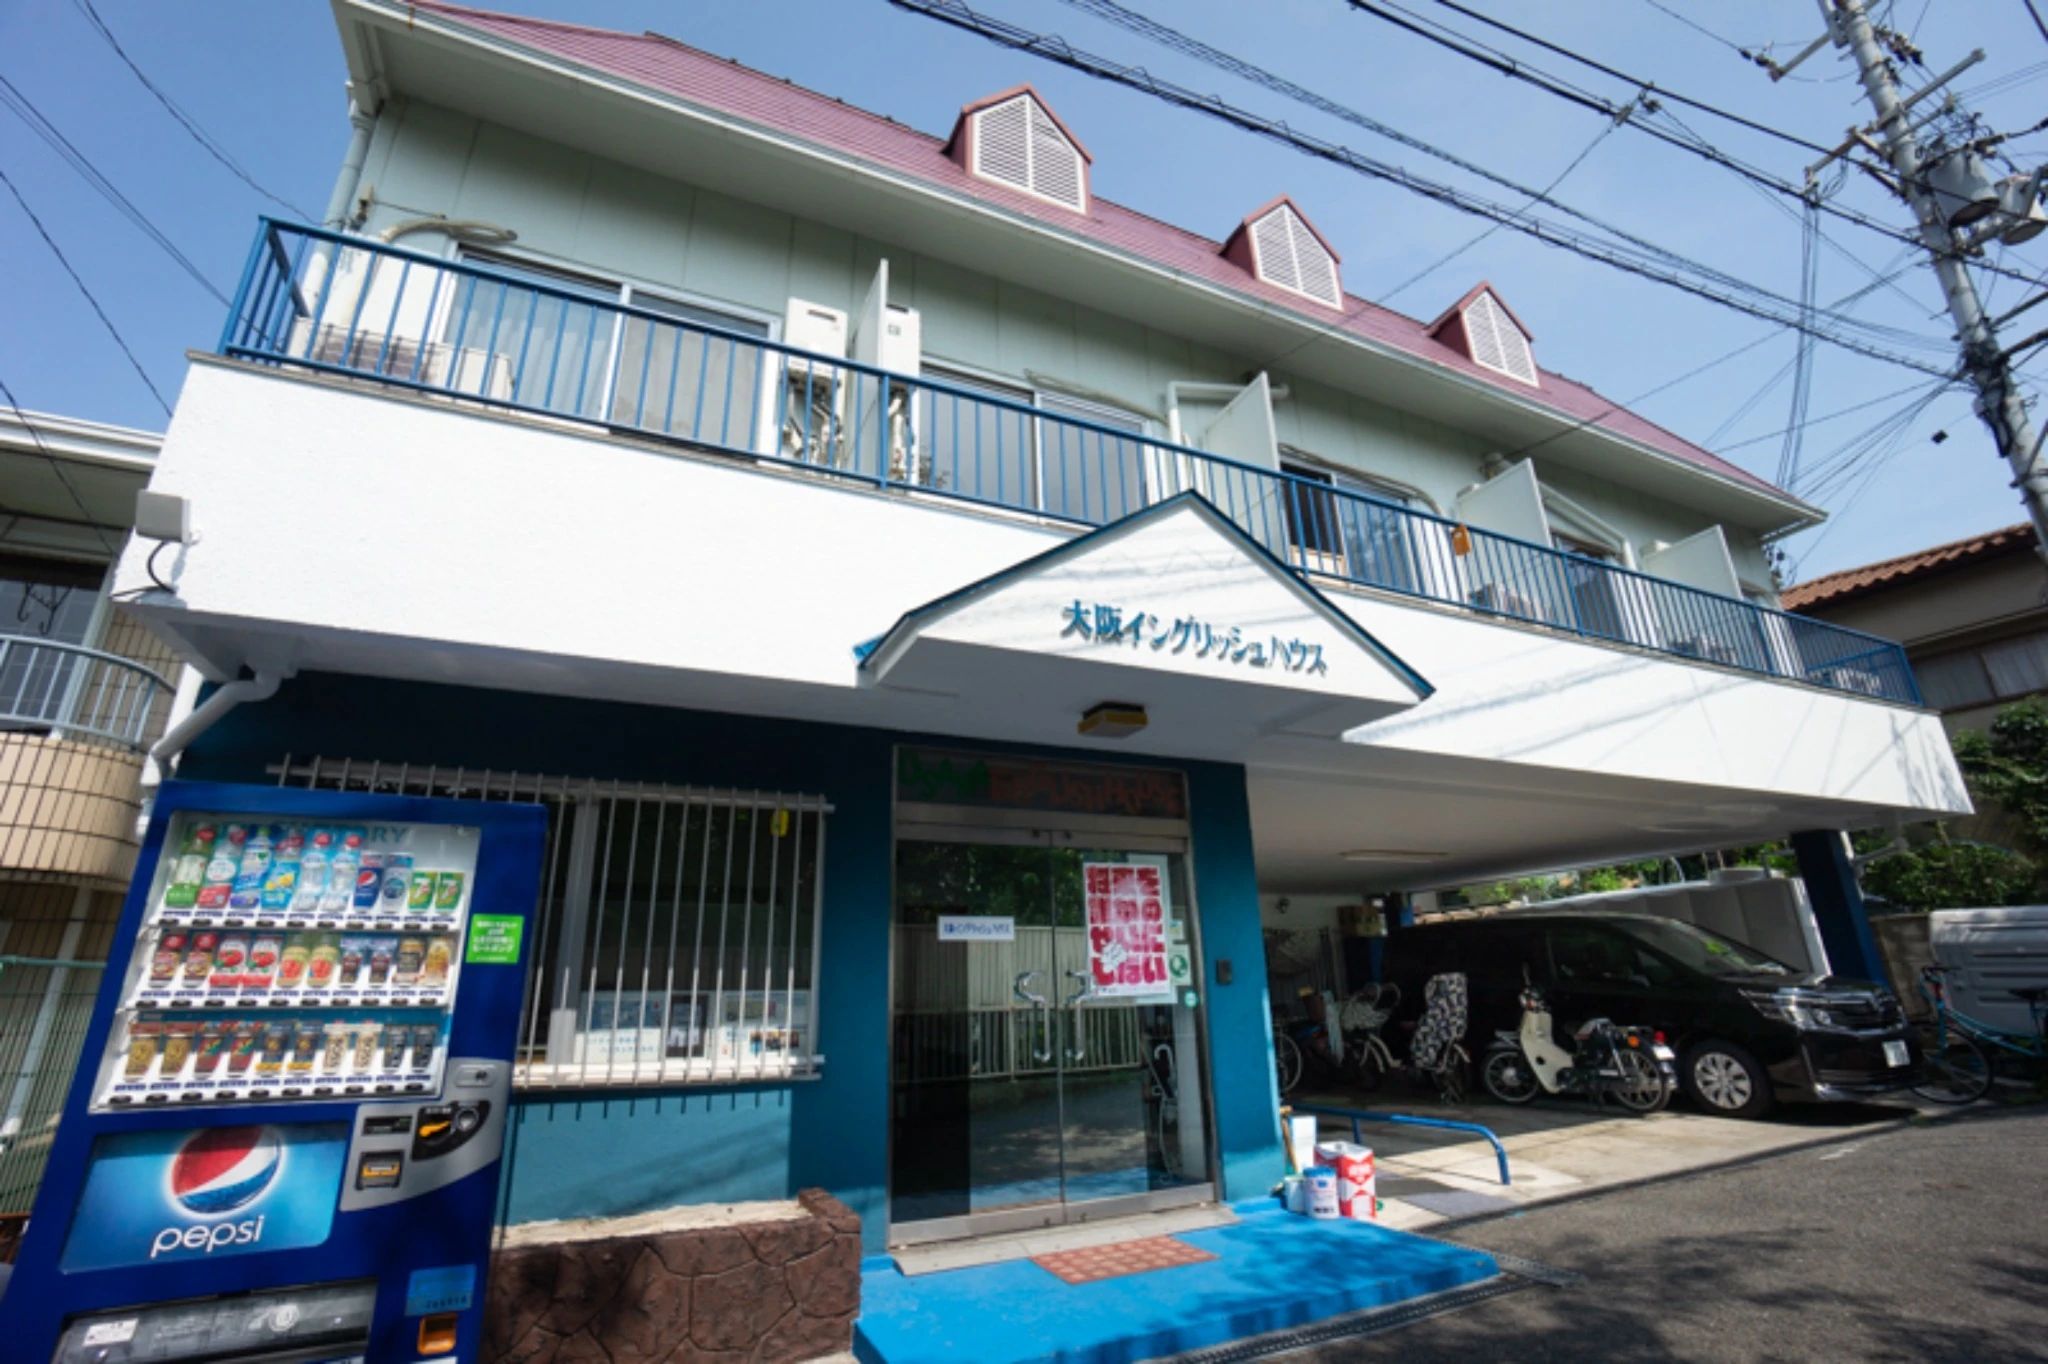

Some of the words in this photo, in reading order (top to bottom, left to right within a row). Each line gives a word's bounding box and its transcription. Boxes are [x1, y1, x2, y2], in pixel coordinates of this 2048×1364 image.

[1060, 599, 1327, 677] 大阪イングリッシュハウス
[150, 1214, 265, 1259] pepsi
